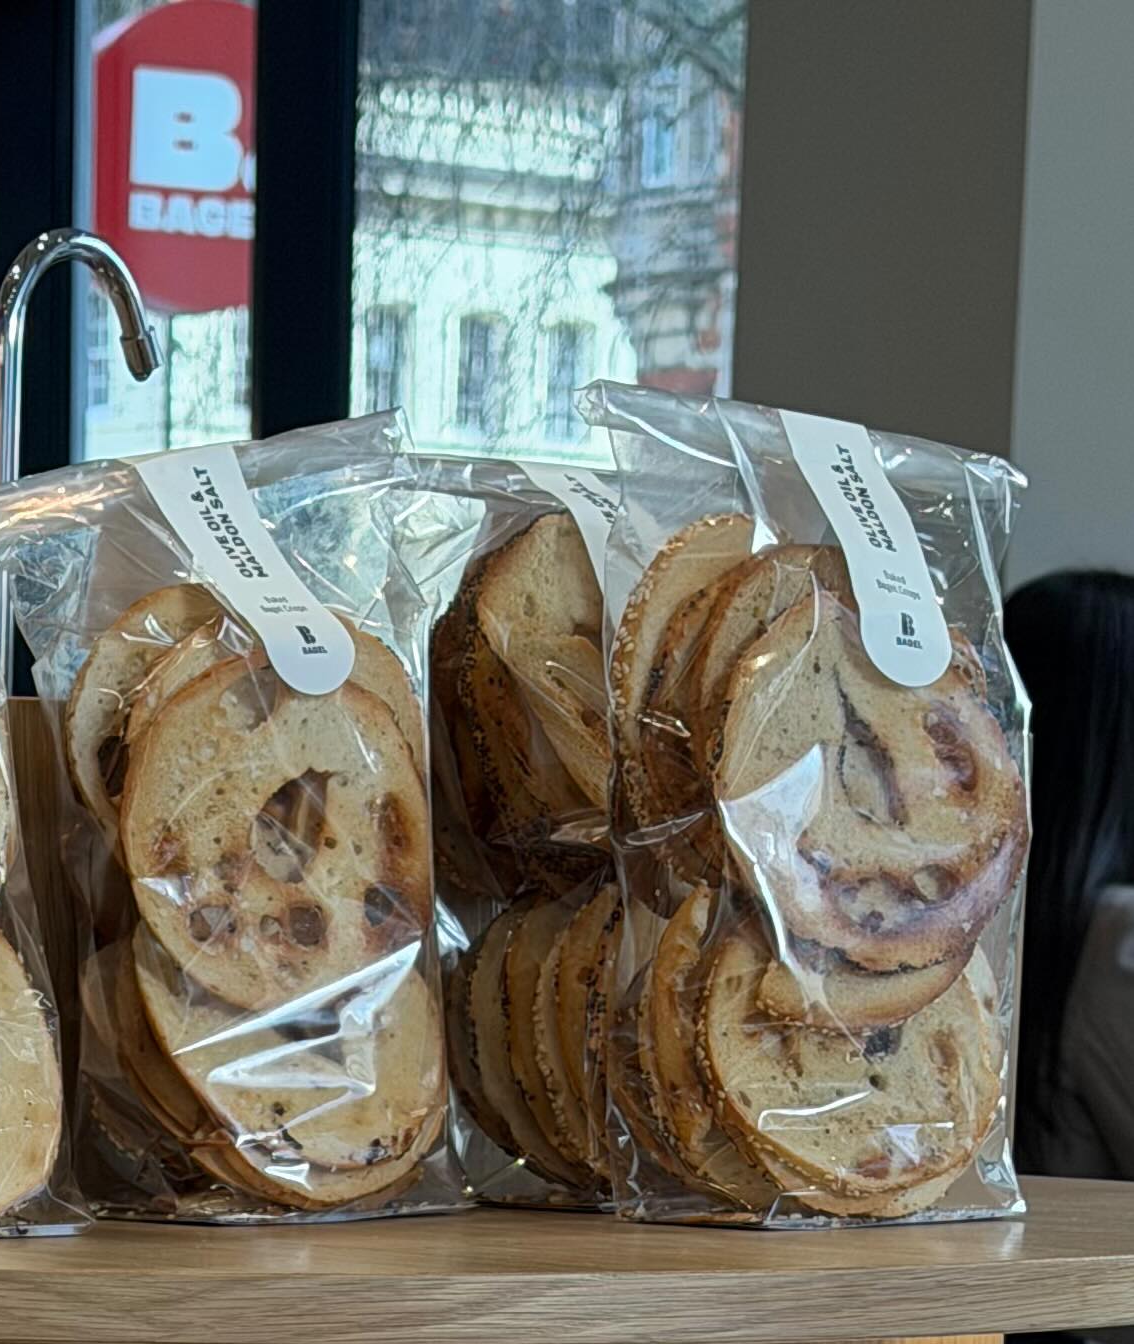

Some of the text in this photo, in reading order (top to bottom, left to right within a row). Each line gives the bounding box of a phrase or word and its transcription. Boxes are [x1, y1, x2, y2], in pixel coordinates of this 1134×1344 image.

[836, 443, 897, 552] MALDON SALT
[837, 477, 857, 502] OIL
[191, 490, 253, 578] OLIVE OIL &
[193, 467, 269, 578] MALDON SALT
[850, 504, 882, 549] OLIVE
[295, 626, 316, 644] B
[901, 612, 915, 636] B
